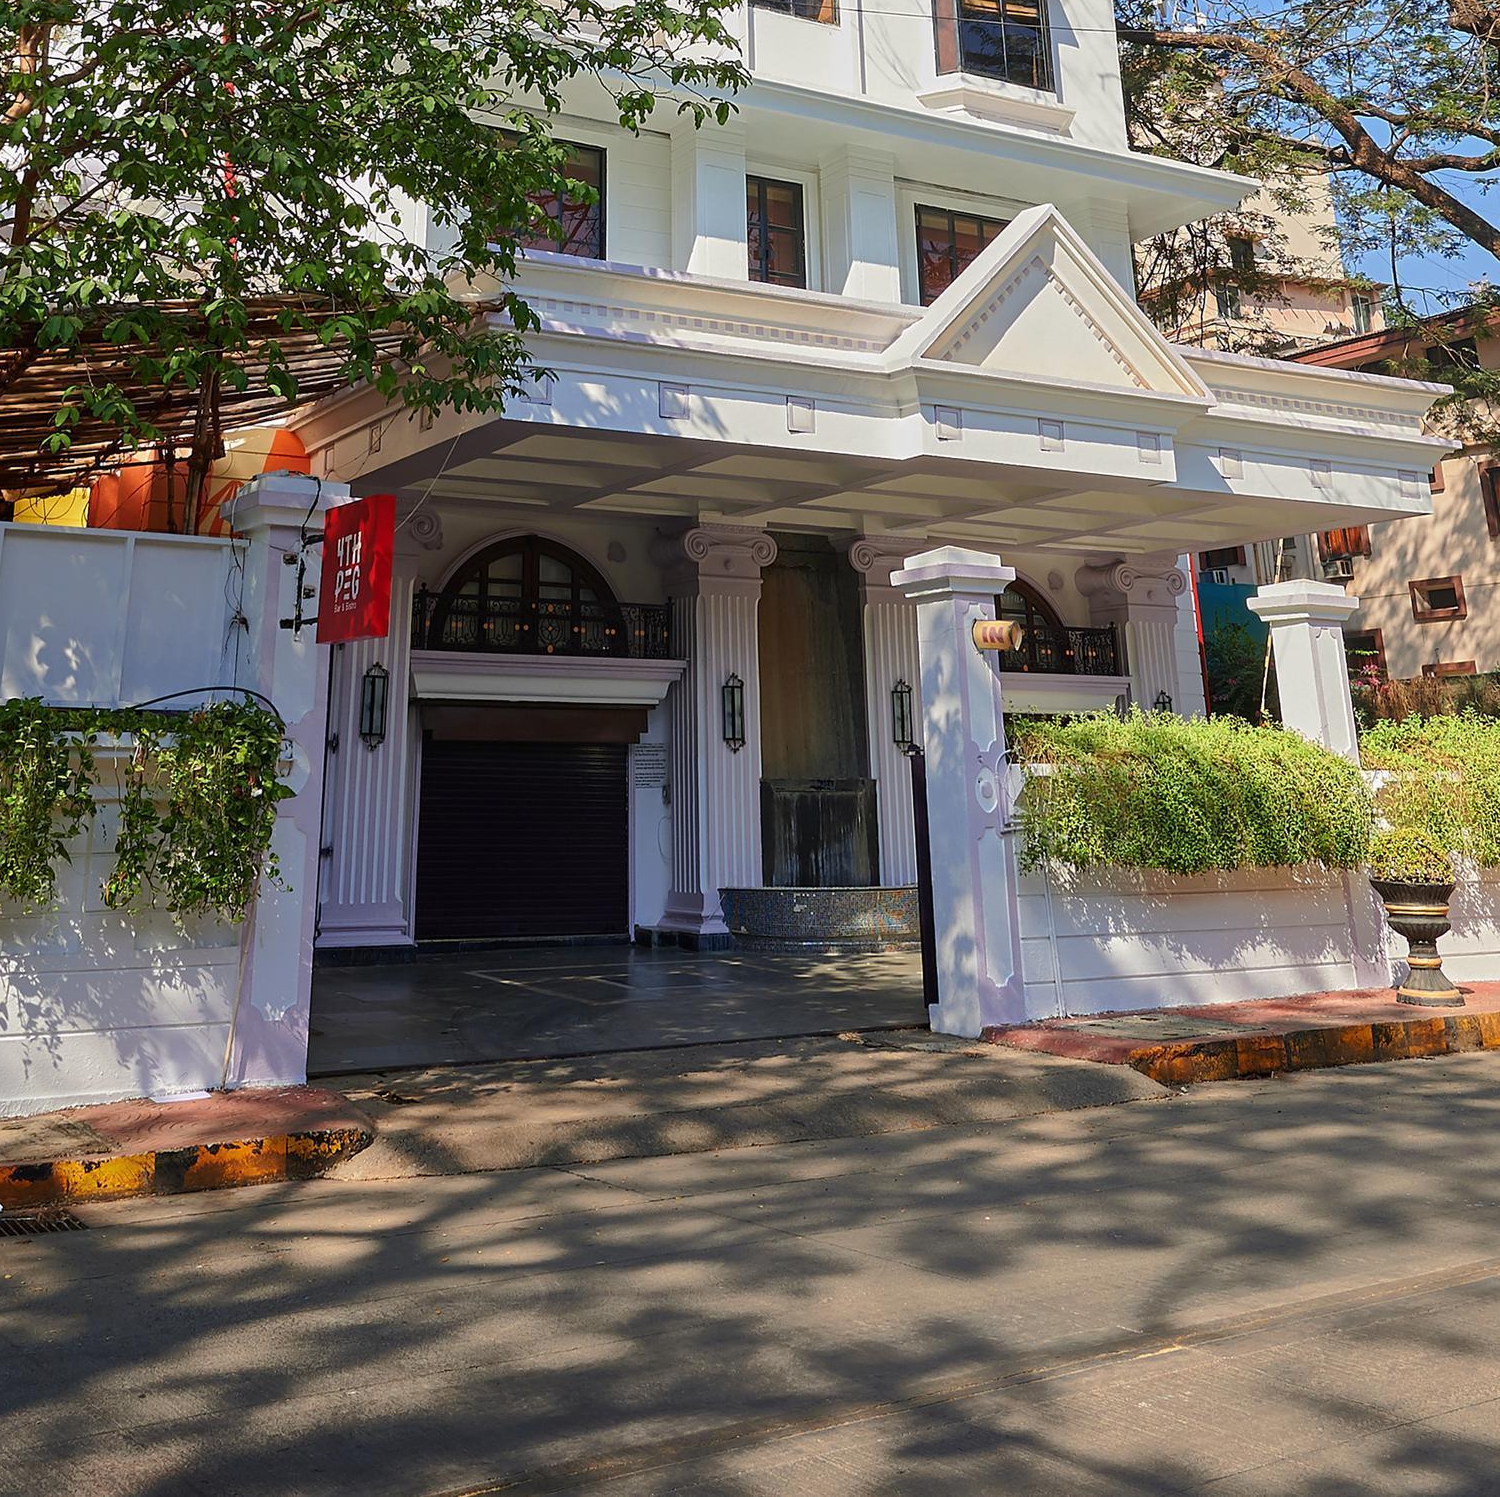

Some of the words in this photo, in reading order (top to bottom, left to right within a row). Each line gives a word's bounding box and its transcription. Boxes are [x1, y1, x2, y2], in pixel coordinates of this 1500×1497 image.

[337, 531, 362, 567] 4TH
[334, 565, 360, 603] PEG
[981, 626, 1005, 644] IN
